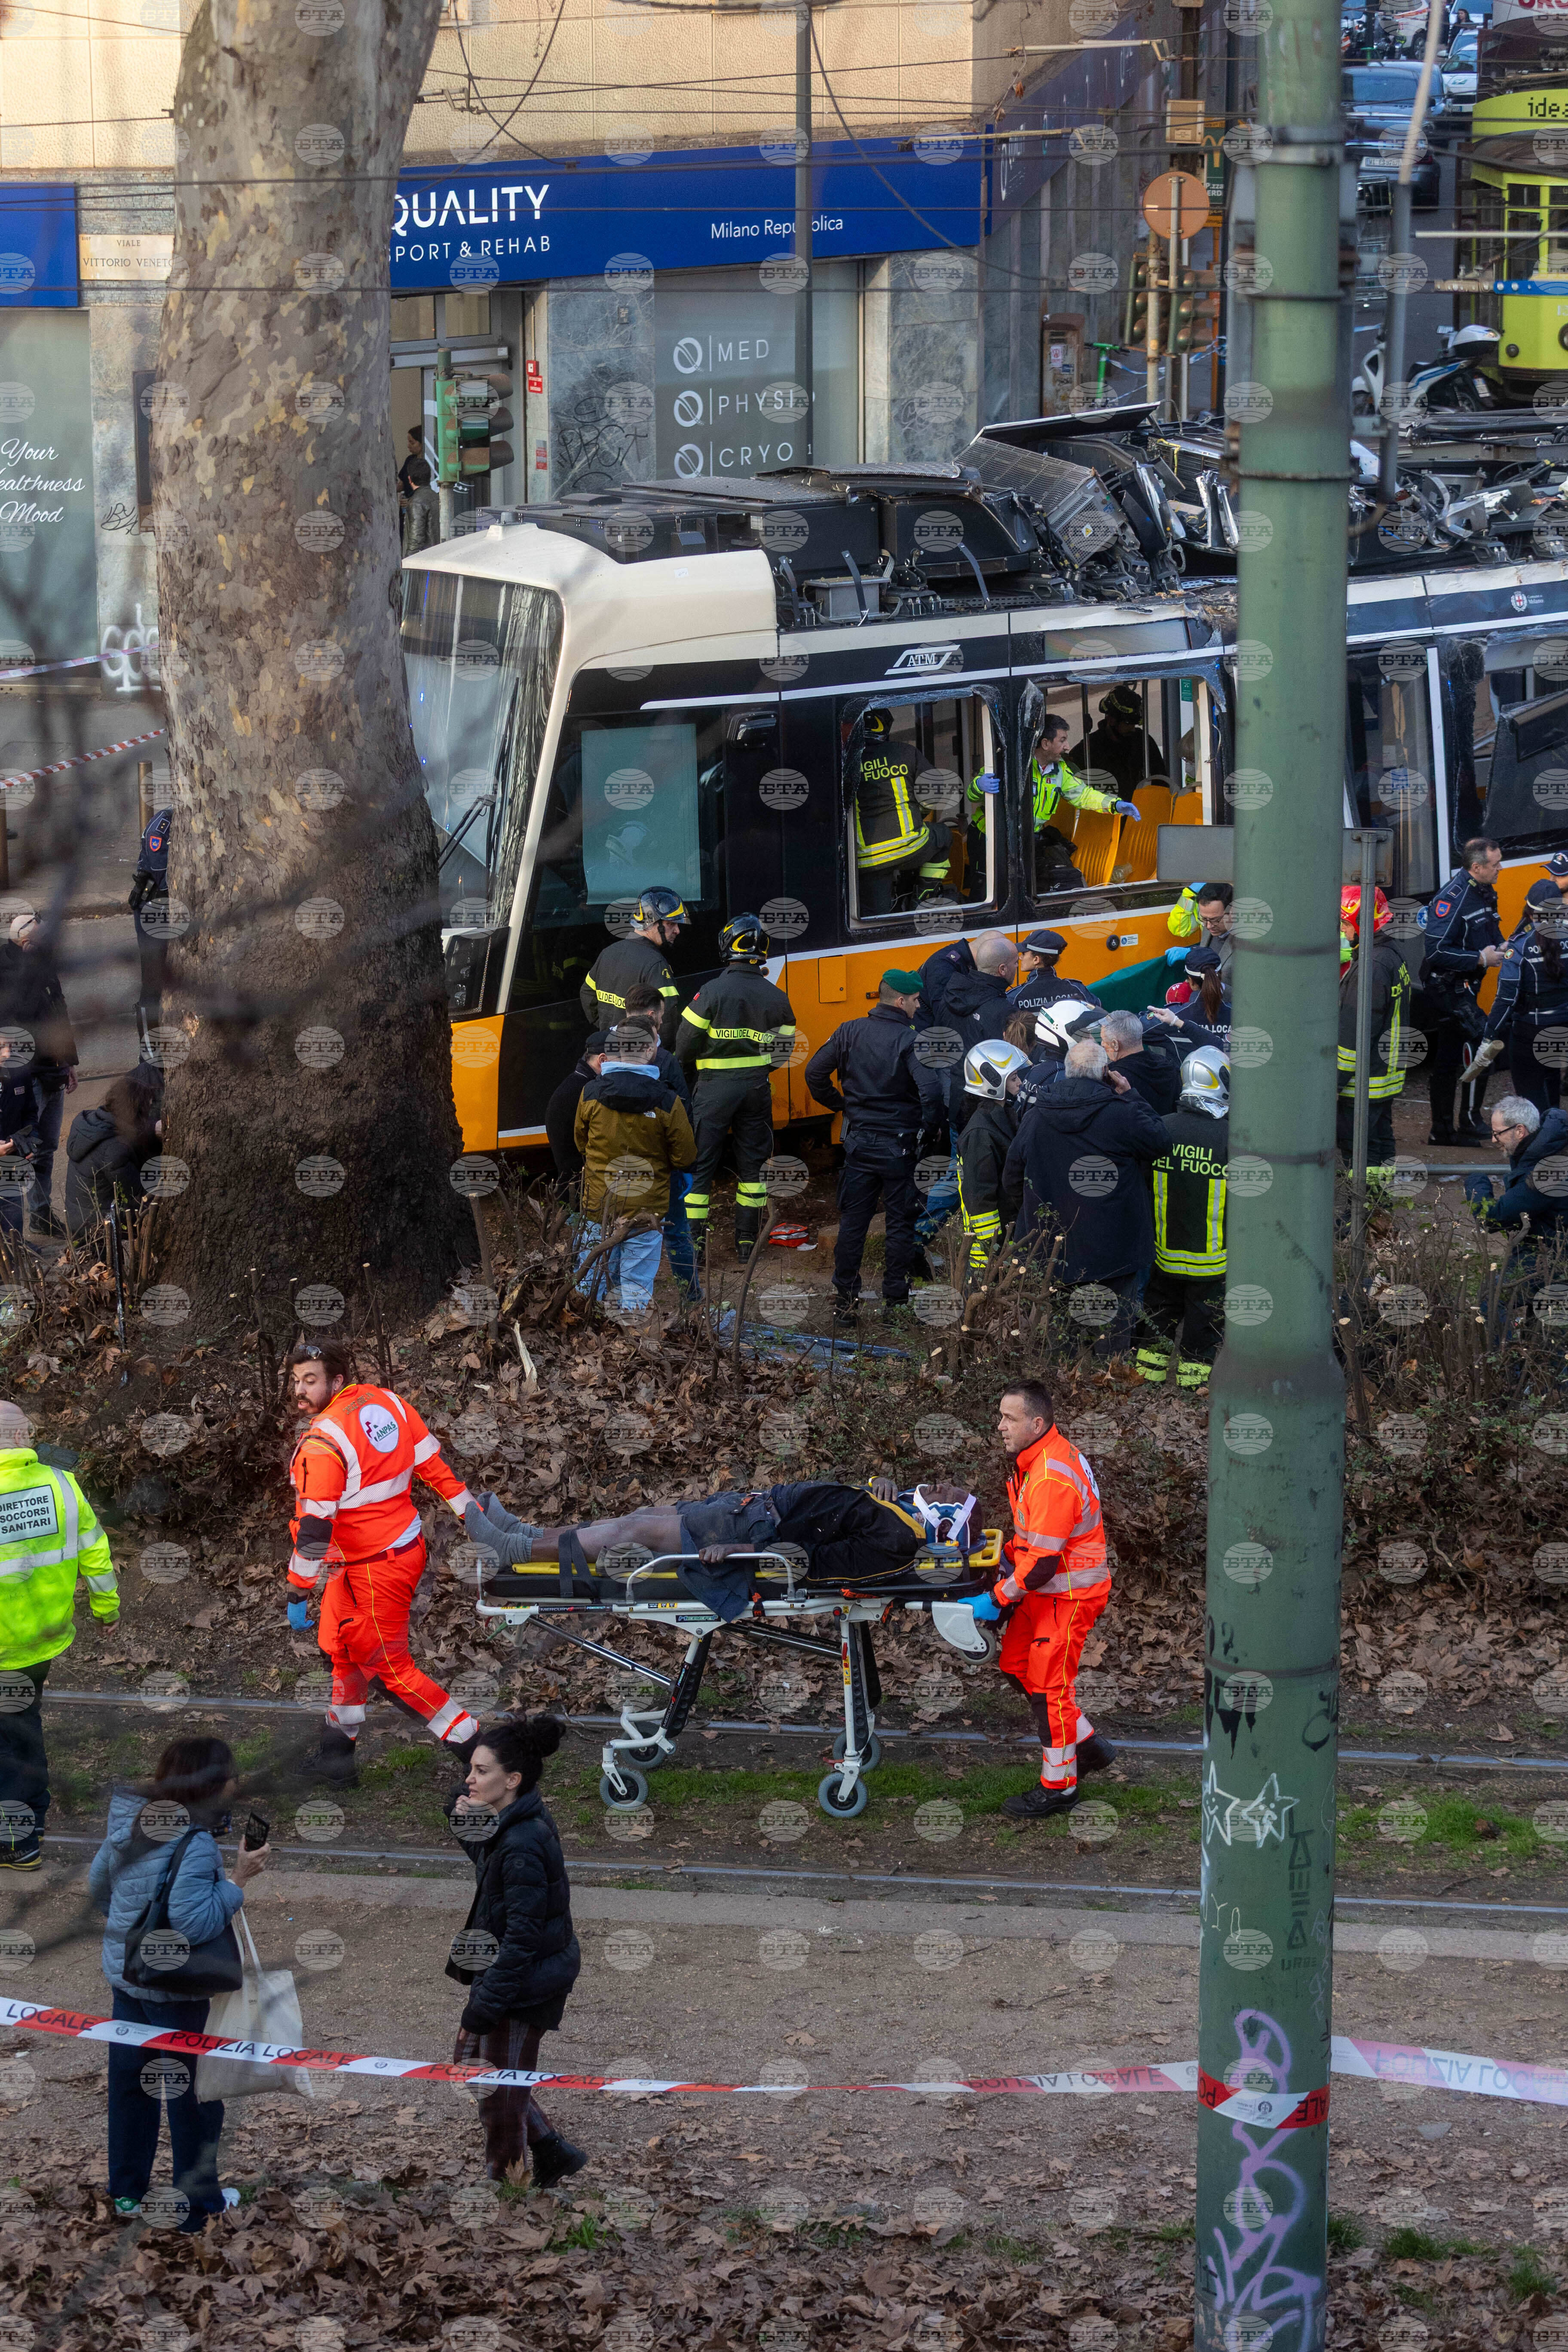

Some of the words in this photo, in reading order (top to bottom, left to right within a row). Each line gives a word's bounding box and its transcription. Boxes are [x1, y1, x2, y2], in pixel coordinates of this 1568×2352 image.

[711, 221, 760, 239] Milano
[389, 243, 450, 262] PORT
[459, 242, 472, 257] &
[481, 236, 550, 256] REHAB
[83, 258, 131, 267] VITTORIO
[719, 340, 769, 362] MED
[719, 389, 815, 415] PHYSI
[1, 438, 59, 467] Your
[720, 442, 793, 468] CRYO
[0, 468, 86, 492] ealthness
[0, 501, 64, 524] Mood
[907, 653, 937, 667] ATM
[861, 757, 888, 773] IGILI
[864, 764, 908, 781] FUOCO
[605, 993, 615, 1003] DEL
[1018, 997, 1048, 1008] POLIZIA
[716, 1030, 738, 1038] VIGILI
[739, 1029, 750, 1038] DEL
[752, 1032, 772, 1043] FUOCO
[1212, 1025, 1232, 1033] LOCA
[1173, 1143, 1212, 1161] VIGILI
[376, 1421, 396, 1439] ANPAS
[0, 1507, 49, 1523] SOCCORSI
[1, 1518, 51, 1534] SANITARI
[6, 2003, 97, 2031] LOCALE
[170, 2032, 255, 2055] POLIZIA
[263, 2045, 355, 2066] LOCALE
[429, 2064, 517, 2081] POLIZIA
[524, 2073, 614, 2086] LOCALE
